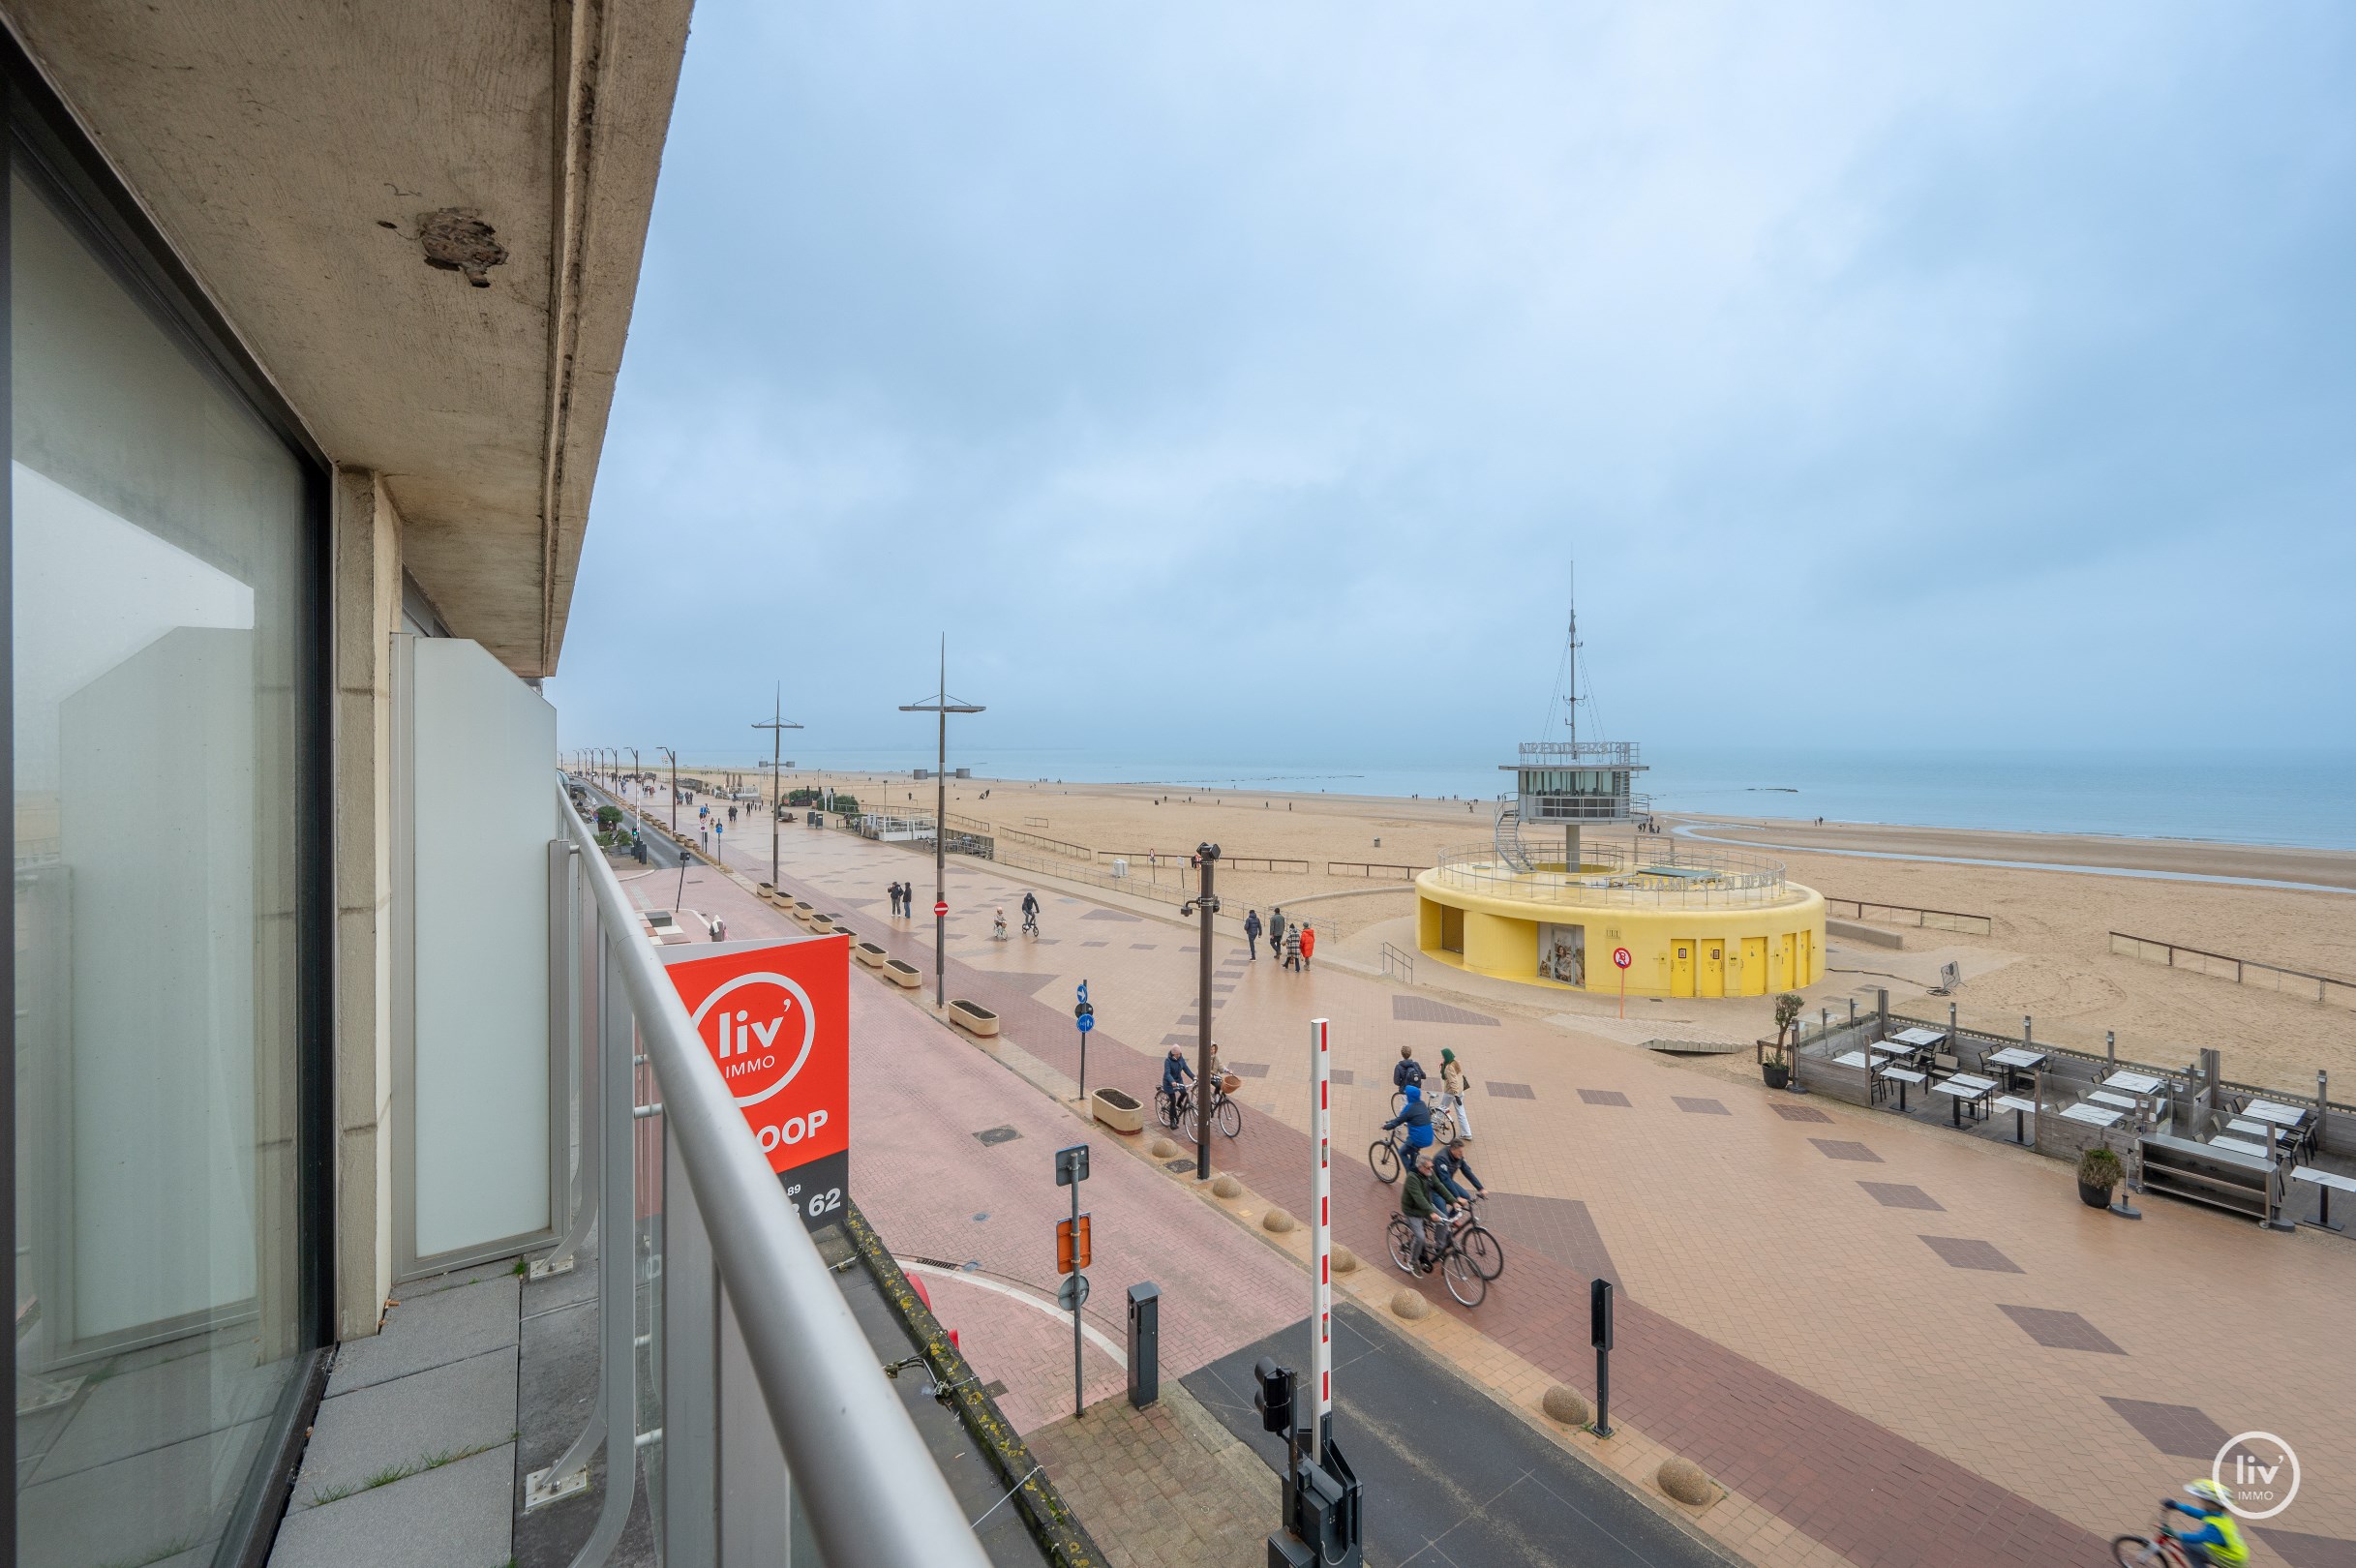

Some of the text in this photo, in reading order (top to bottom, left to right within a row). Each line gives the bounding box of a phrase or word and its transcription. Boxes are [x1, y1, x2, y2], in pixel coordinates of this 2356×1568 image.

[725, 1055, 775, 1079] IMMO
[755, 1109, 829, 1154] OOP
[808, 1188, 841, 1217] 62
